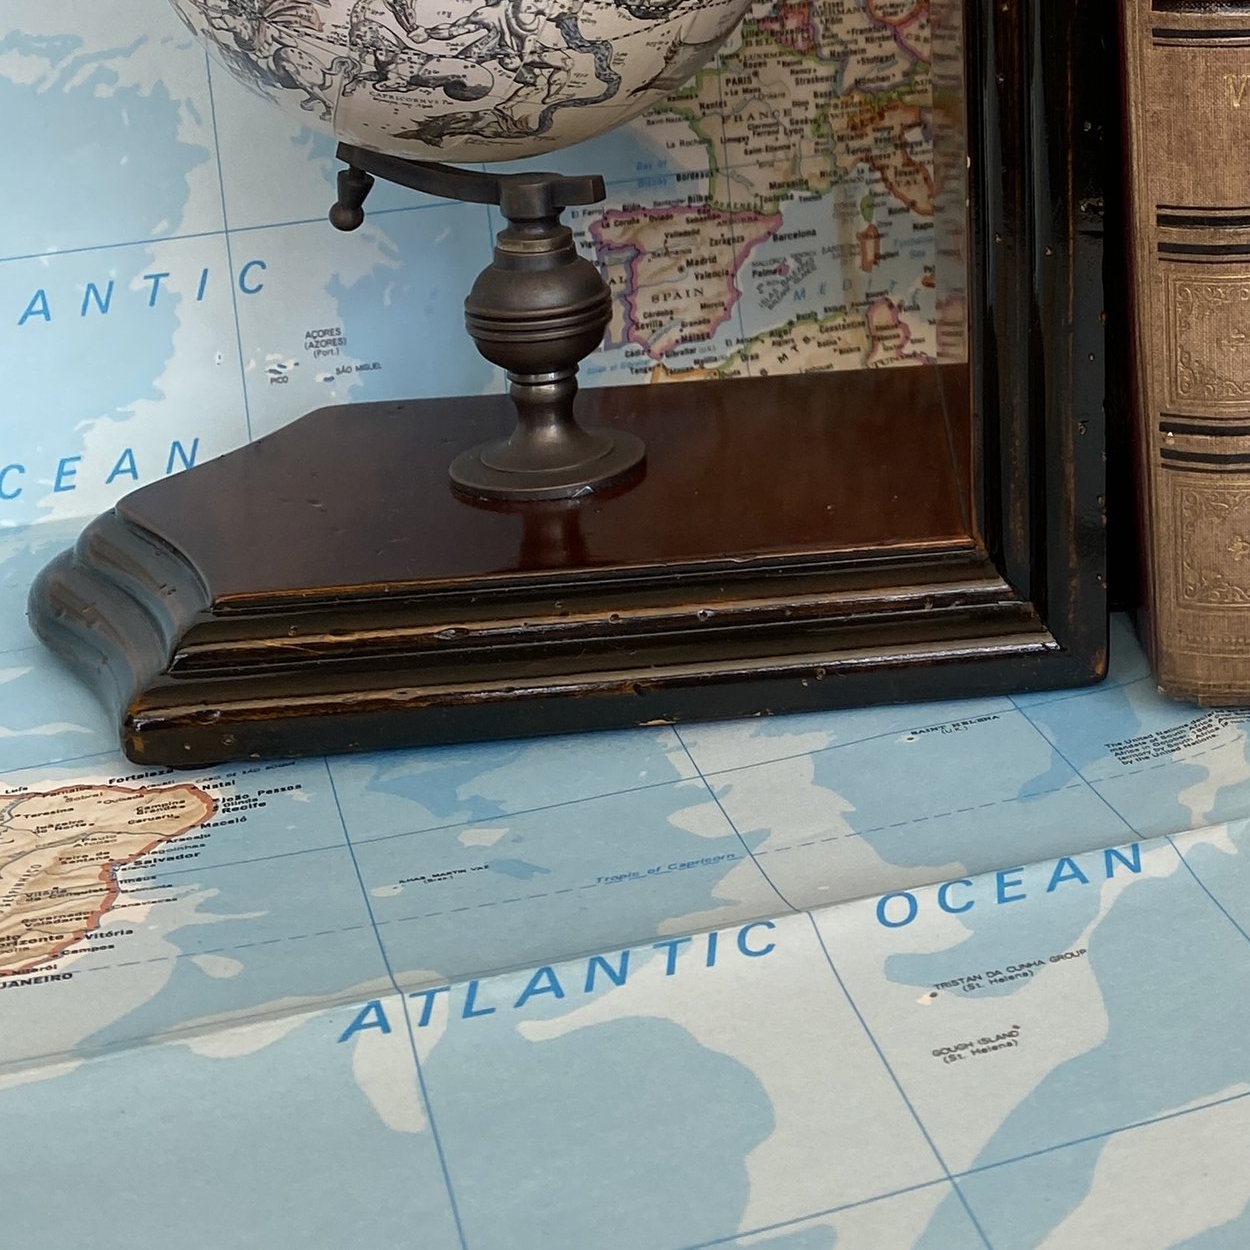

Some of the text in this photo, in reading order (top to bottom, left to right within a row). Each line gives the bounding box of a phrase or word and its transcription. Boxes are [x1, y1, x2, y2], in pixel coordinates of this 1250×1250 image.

[725, 76, 753, 86] PARIS
[773, 229, 816, 241] Barcelona
[686, 256, 717, 267] Madrid
[694, 270, 729, 280] Valencia
[18, 260, 267, 325] ANTIC
[651, 288, 705, 303] SPAIN
[635, 320, 663, 330] Sevilla
[305, 328, 341, 339] AÇORES
[305, 337, 347, 350] (AZORES)
[0, 438, 200, 501] CEAN
[911, 716, 1000, 735] SAINT HELENA
[1110, 741, 1147, 752] mandate
[1160, 730, 1187, 740] South
[1189, 719, 1213, 730] Africa
[1124, 734, 1153, 744] United
[1155, 723, 1189, 736] Nations
[1117, 750, 1151, 761] territory
[1167, 737, 1193, 748] South
[1195, 727, 1220, 738] Africa
[1114, 748, 1140, 757] Africa
[1152, 747, 1181, 758] United
[108, 768, 174, 785] Fortaleza
[202, 780, 236, 790] Natal
[257, 784, 302, 796] Pessoa
[23, 807, 74, 819] Teresina
[222, 801, 267, 814] Recife
[134, 852, 200, 866] Salvador
[647, 865, 662, 874] of
[667, 852, 736, 871] Capricorn
[85, 929, 134, 940] Vitória
[61, 944, 115, 956] Campos
[338, 843, 1144, 1043] ATLANTIC OCEAN
[934, 948, 1087, 990] TRISTAN DA CUNHA GROUP
[0, 972, 73, 989] JANEIRO
[989, 970, 1034, 985] Helena)
[932, 1030, 1020, 1057] GOUGH ISLAND
[970, 1039, 1018, 1056] Helena)
